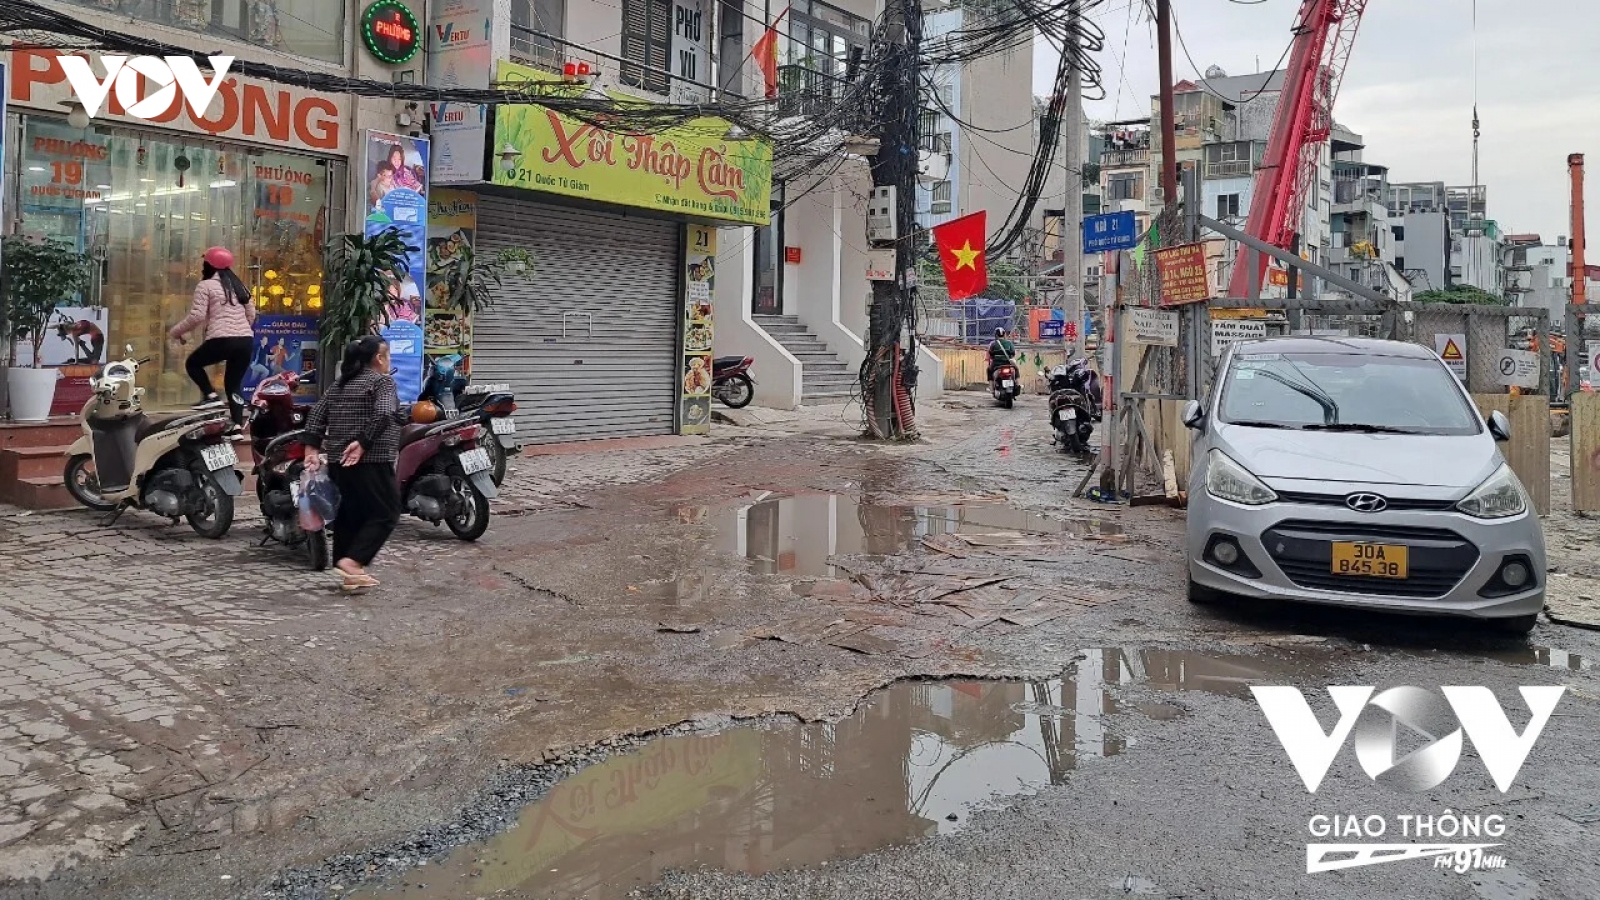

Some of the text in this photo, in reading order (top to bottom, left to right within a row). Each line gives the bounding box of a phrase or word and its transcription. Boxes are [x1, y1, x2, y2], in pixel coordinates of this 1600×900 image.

[541, 110, 746, 202] Xôi Thập Cẩm
[50, 161, 82, 185] 19
[519, 169, 532, 182] 21
[695, 230, 708, 247] 21
[1353, 545, 1386, 560] 30A
[1339, 560, 1399, 576] 845.38
